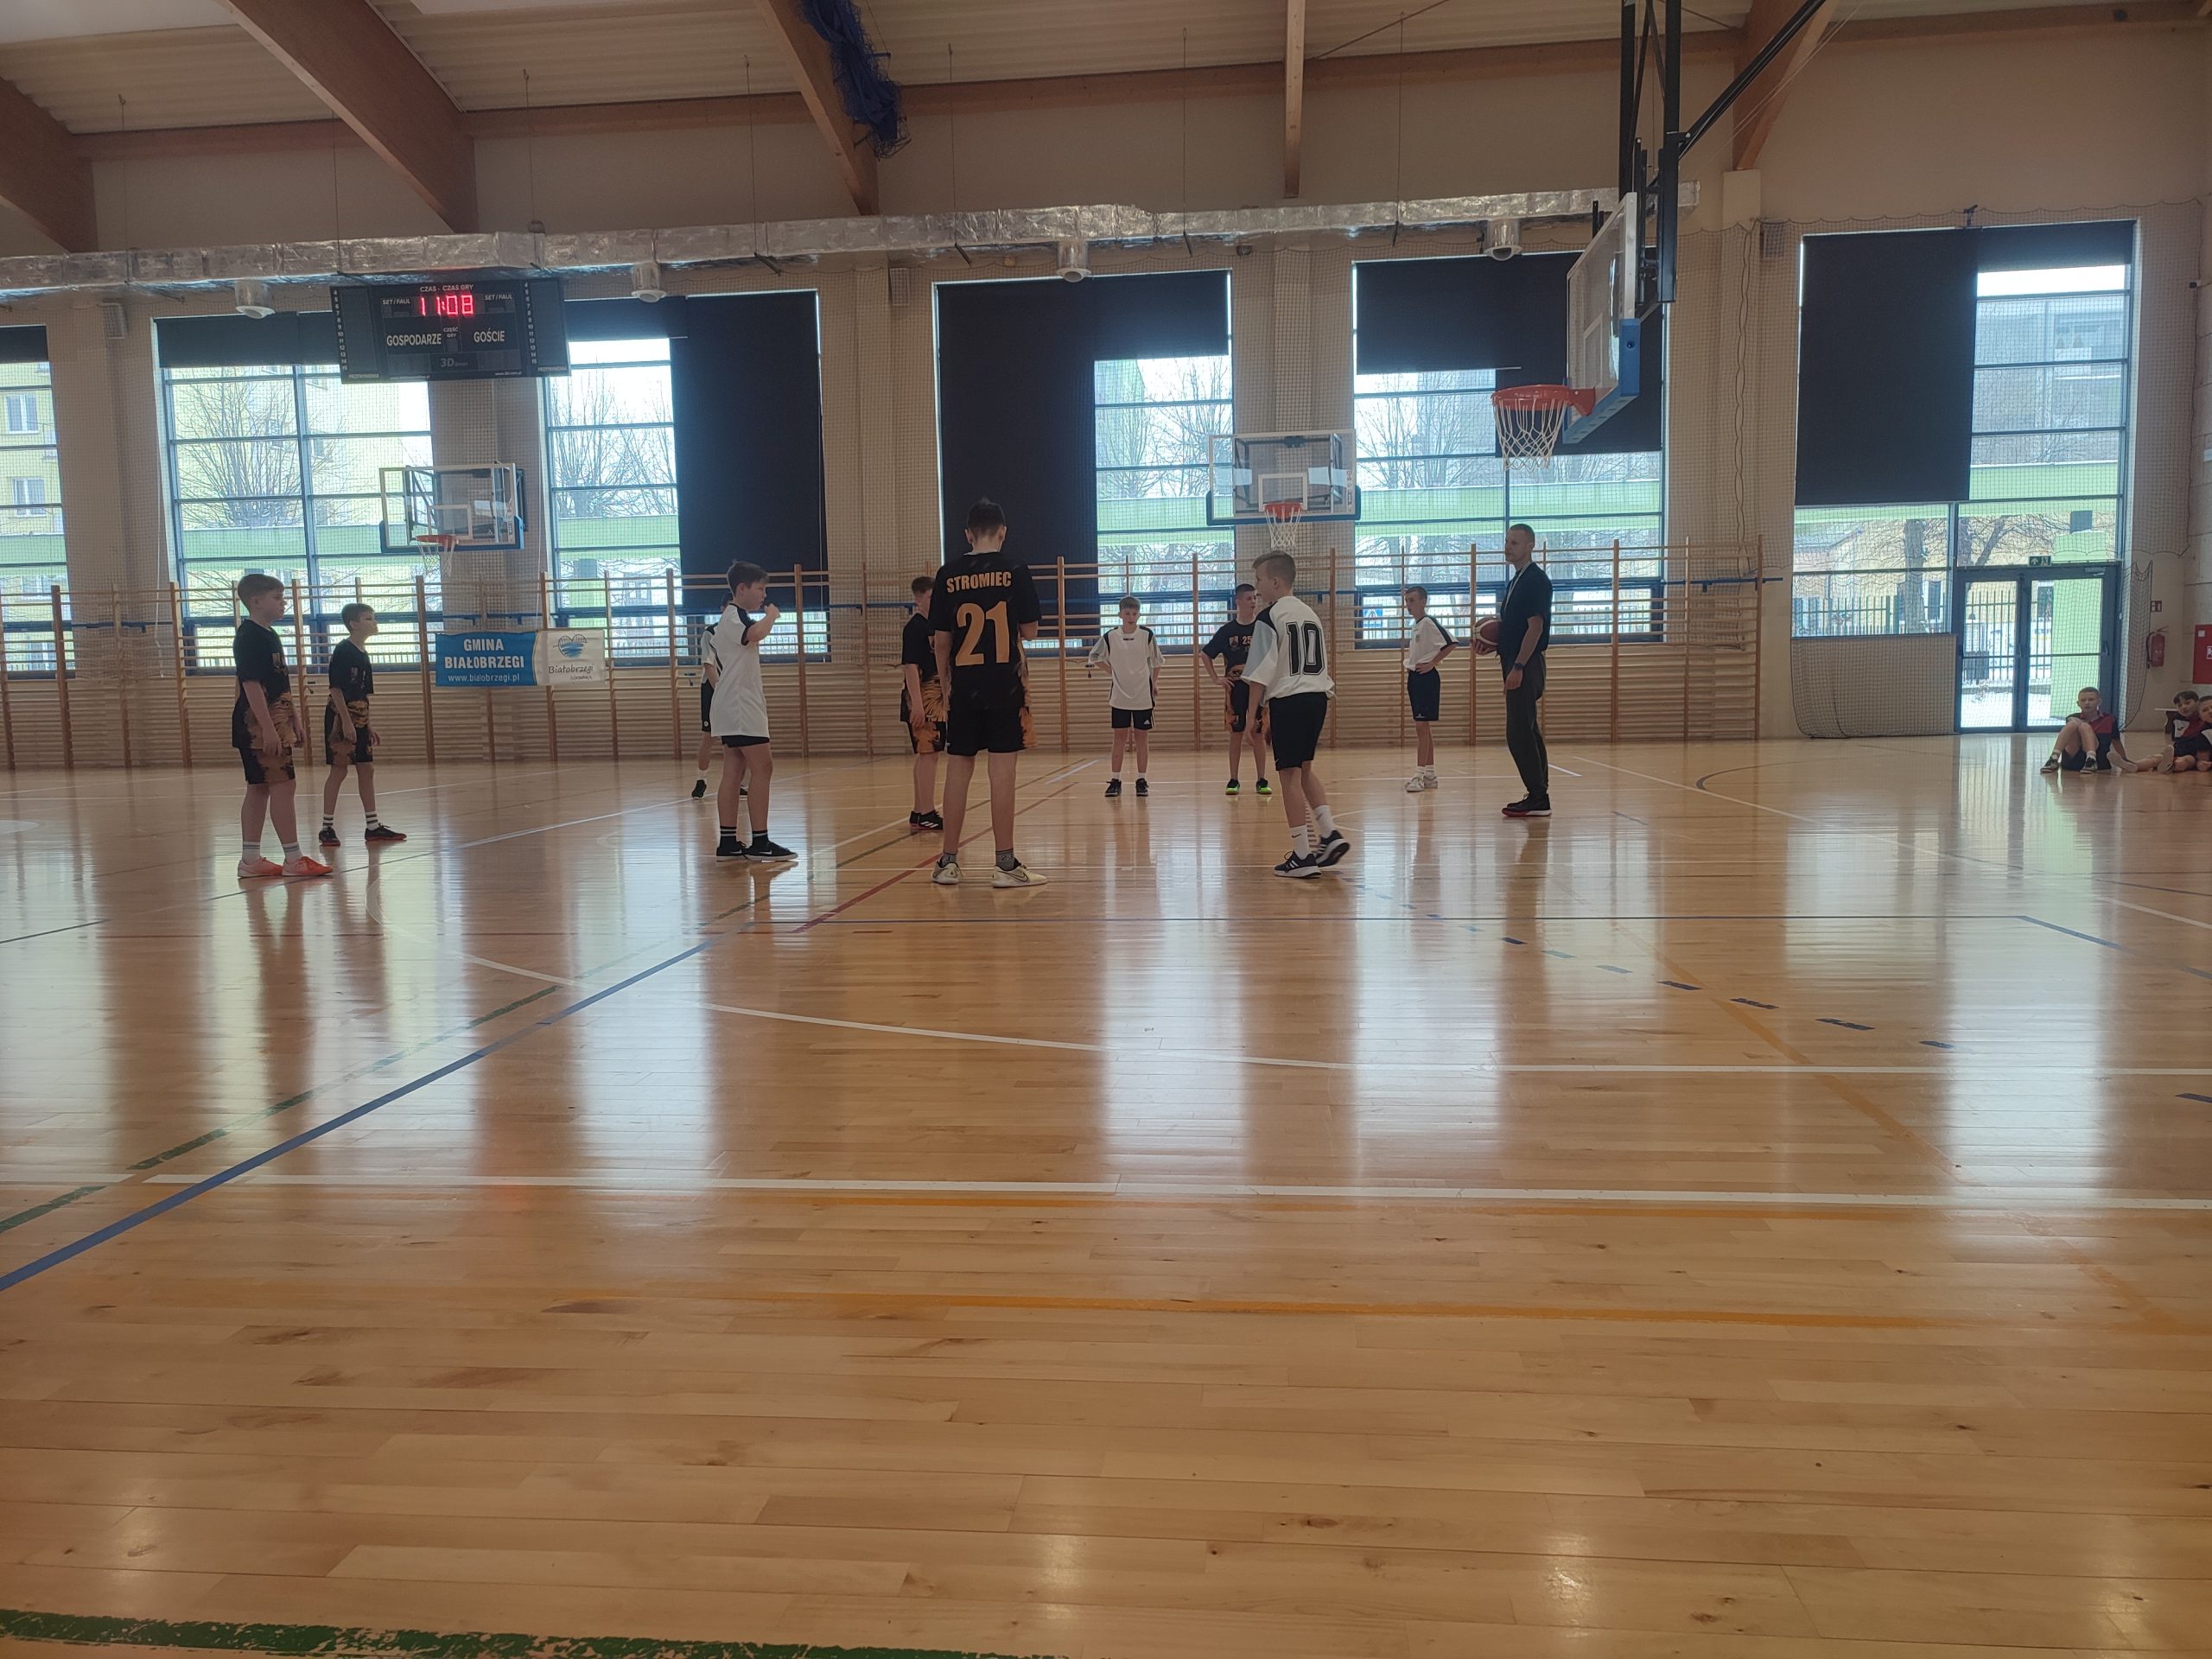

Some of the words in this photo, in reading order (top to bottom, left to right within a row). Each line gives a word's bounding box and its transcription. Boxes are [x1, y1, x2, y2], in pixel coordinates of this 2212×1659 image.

[421, 295, 474, 316] 11:08
[387, 333, 442, 346] GOSPODARZE
[474, 327, 505, 342] GOŚCIE
[441, 358, 454, 367] 3D
[946, 571, 1012, 593] STROMIEC
[955, 601, 1010, 667] 21
[463, 639, 505, 652] GMINA
[1286, 620, 1325, 677] 10
[444, 655, 524, 669] BIAŁOBRZEGI
[548, 664, 594, 677] Białobrzegi
[448, 673, 519, 683] www.bialobrzegi.pl
